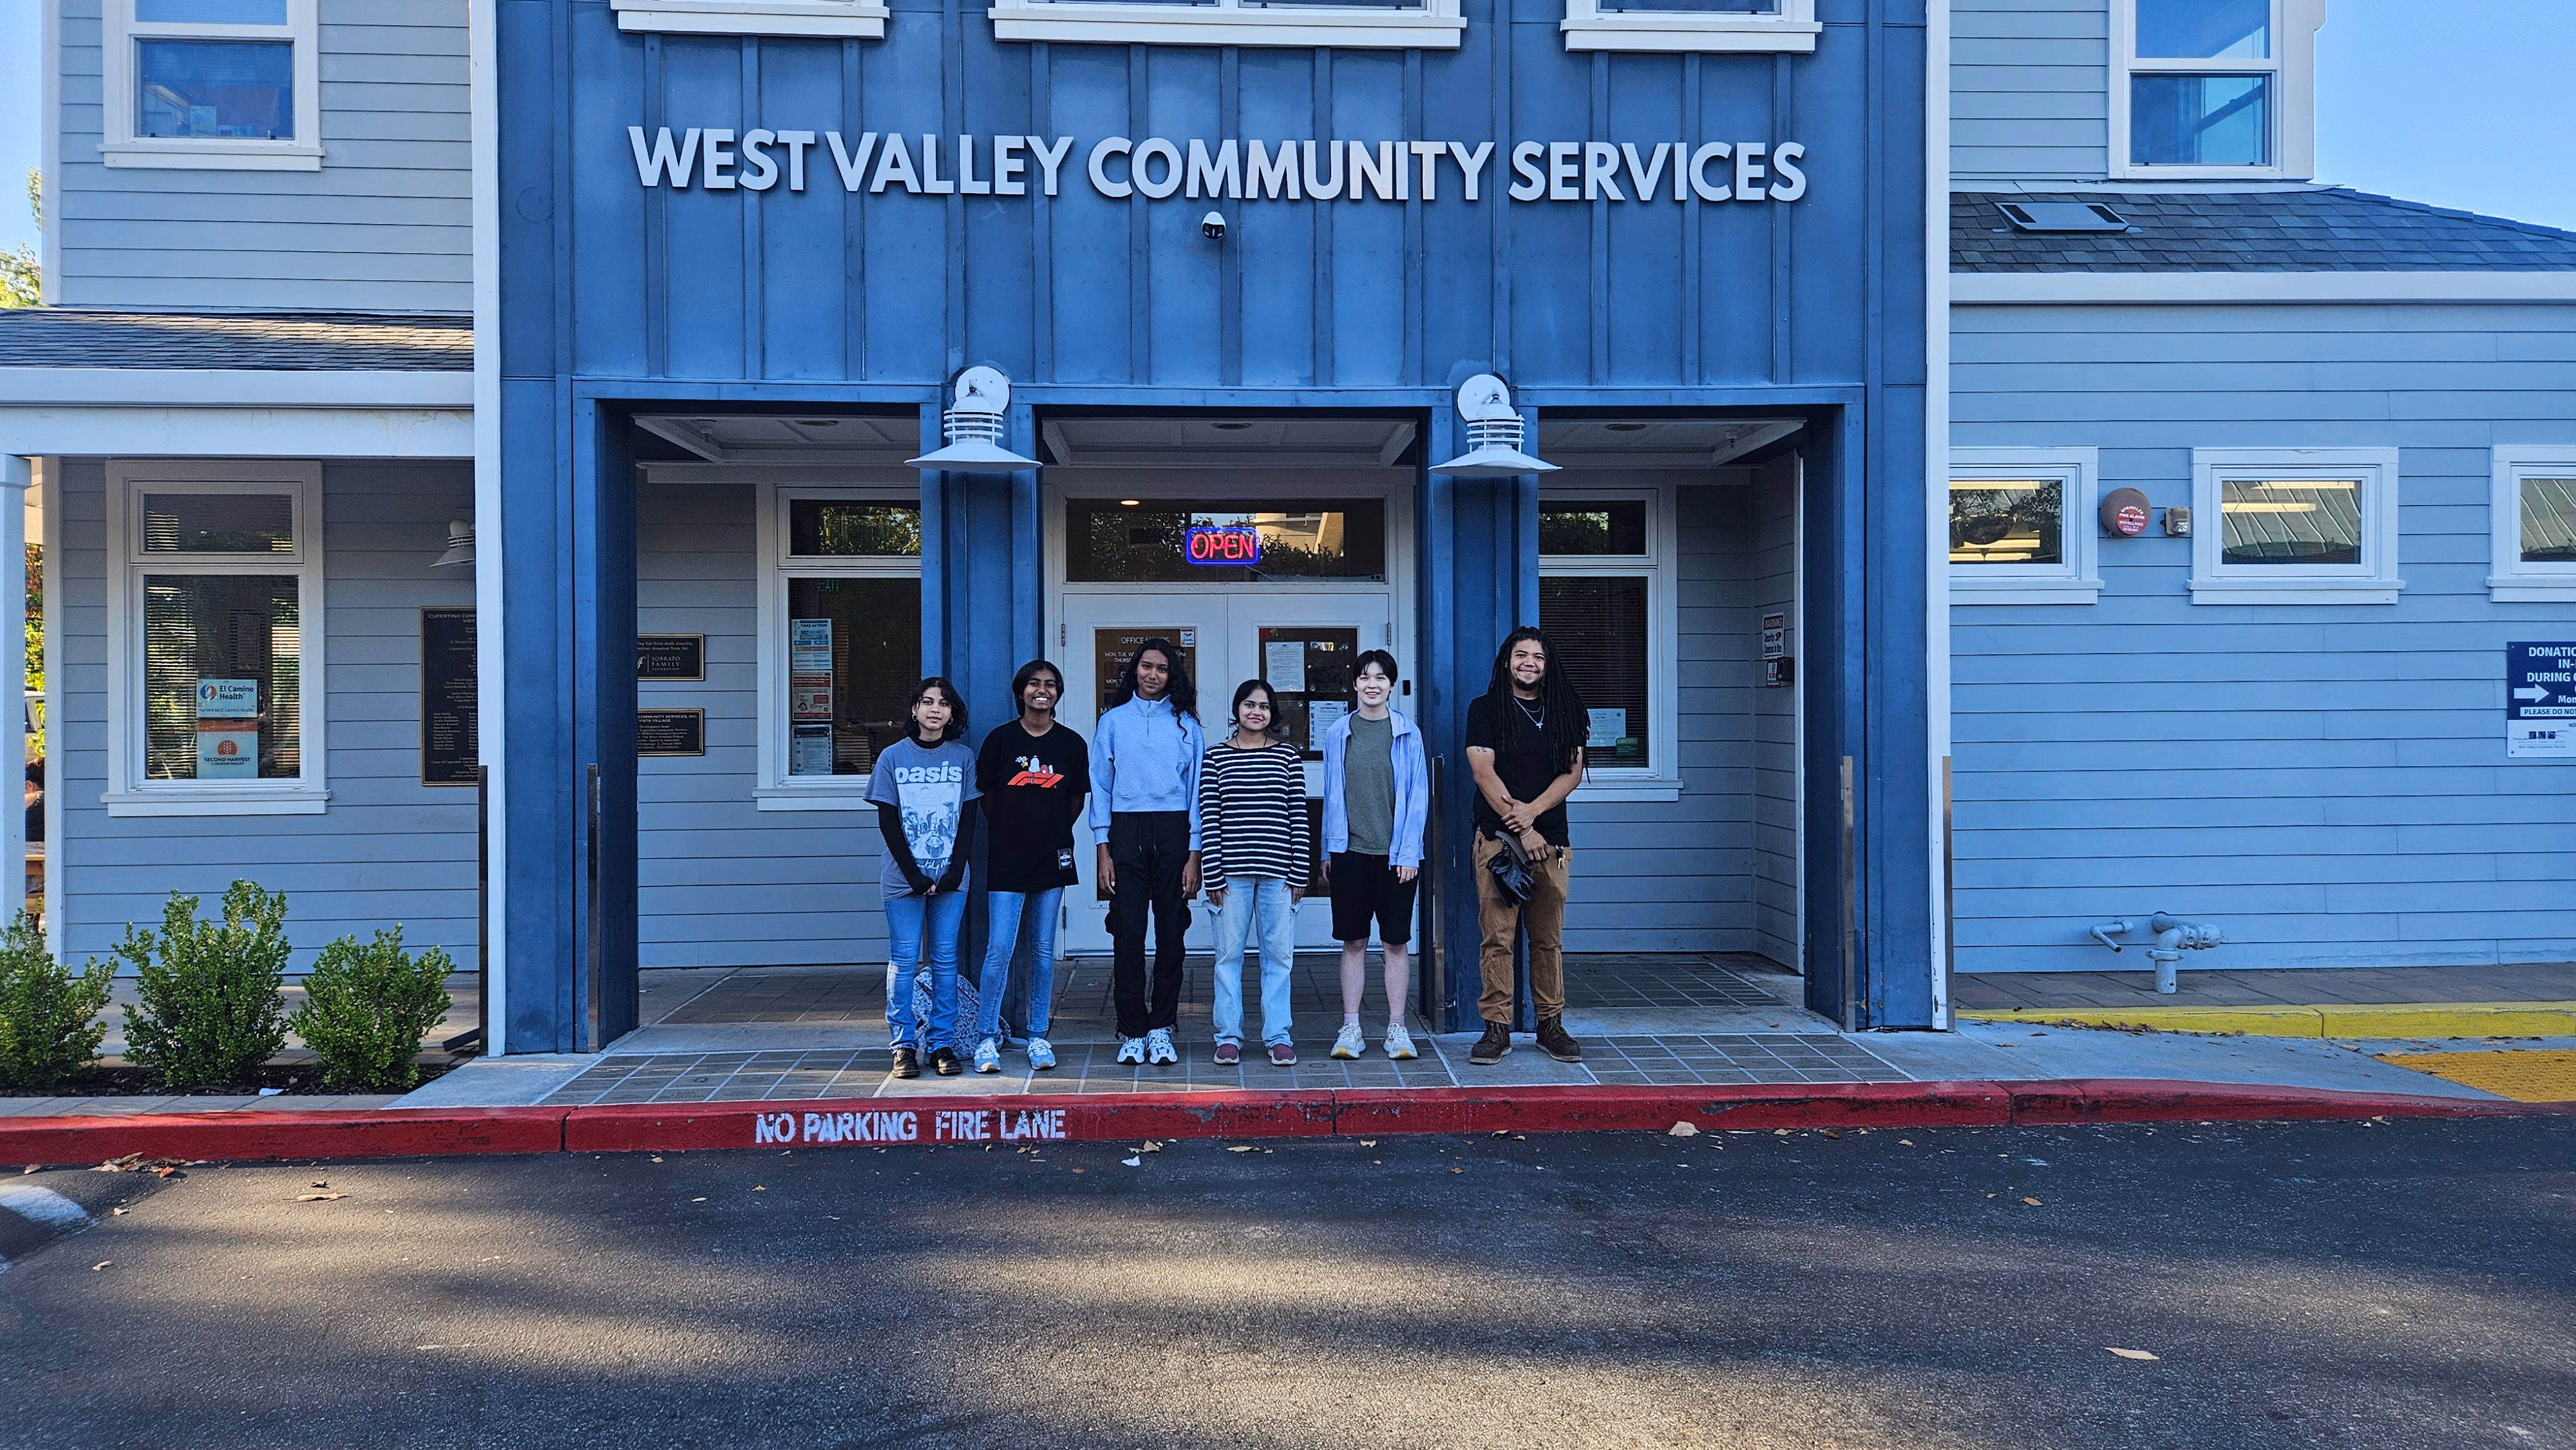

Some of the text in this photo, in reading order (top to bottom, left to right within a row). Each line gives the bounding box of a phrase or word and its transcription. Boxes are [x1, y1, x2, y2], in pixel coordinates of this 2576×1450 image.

[627, 126, 1806, 202] WEST VALLEY COMMUNITY SERVICES
[2120, 506, 2144, 515] SPRINKLER
[1191, 534, 1255, 559] OPEN
[1765, 617, 1783, 629] WARNING
[2528, 647, 2576, 657] DONATIO
[2558, 659, 2576, 669] IN-
[2527, 672, 2571, 682] DURING
[895, 761, 962, 783] oasis
[756, 1110, 1065, 1143] NO PARKING FIRE LANE
